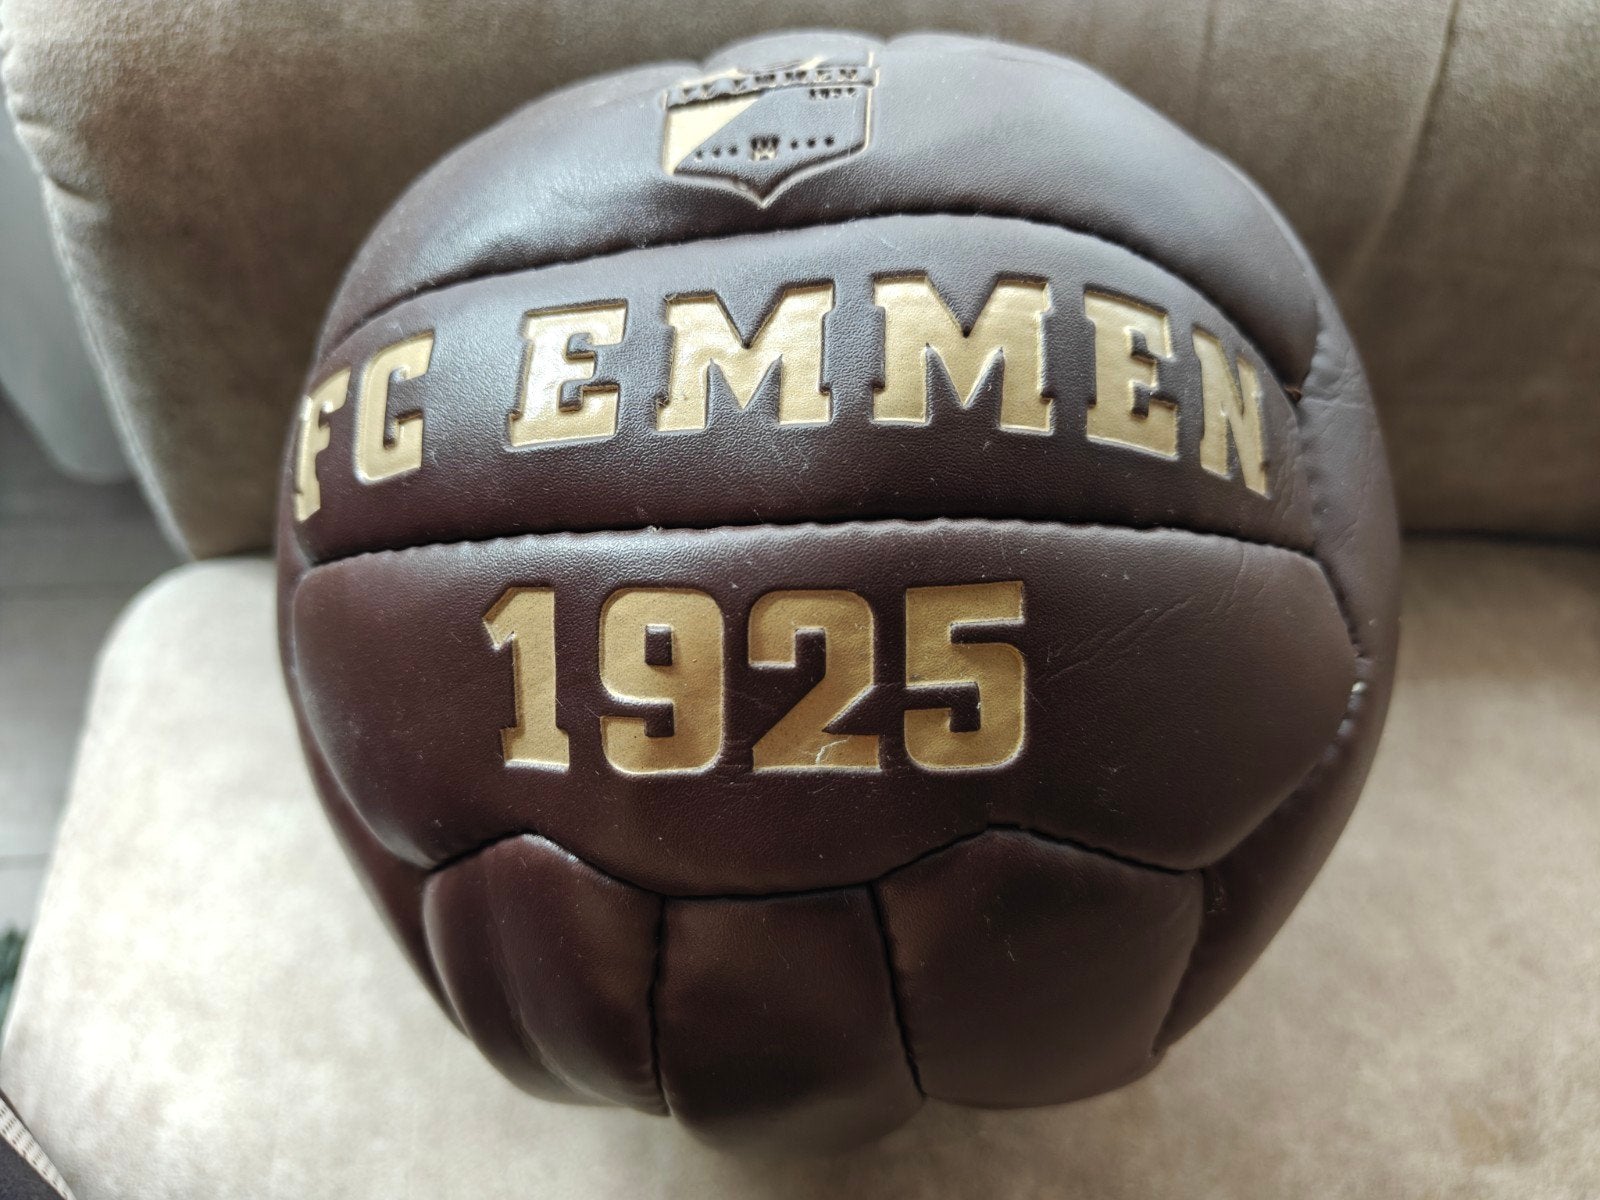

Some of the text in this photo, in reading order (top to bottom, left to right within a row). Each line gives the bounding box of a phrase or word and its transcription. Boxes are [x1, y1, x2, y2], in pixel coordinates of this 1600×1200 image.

[295, 273, 1269, 522] FC EMMEN
[483, 581, 1026, 776] 1925
